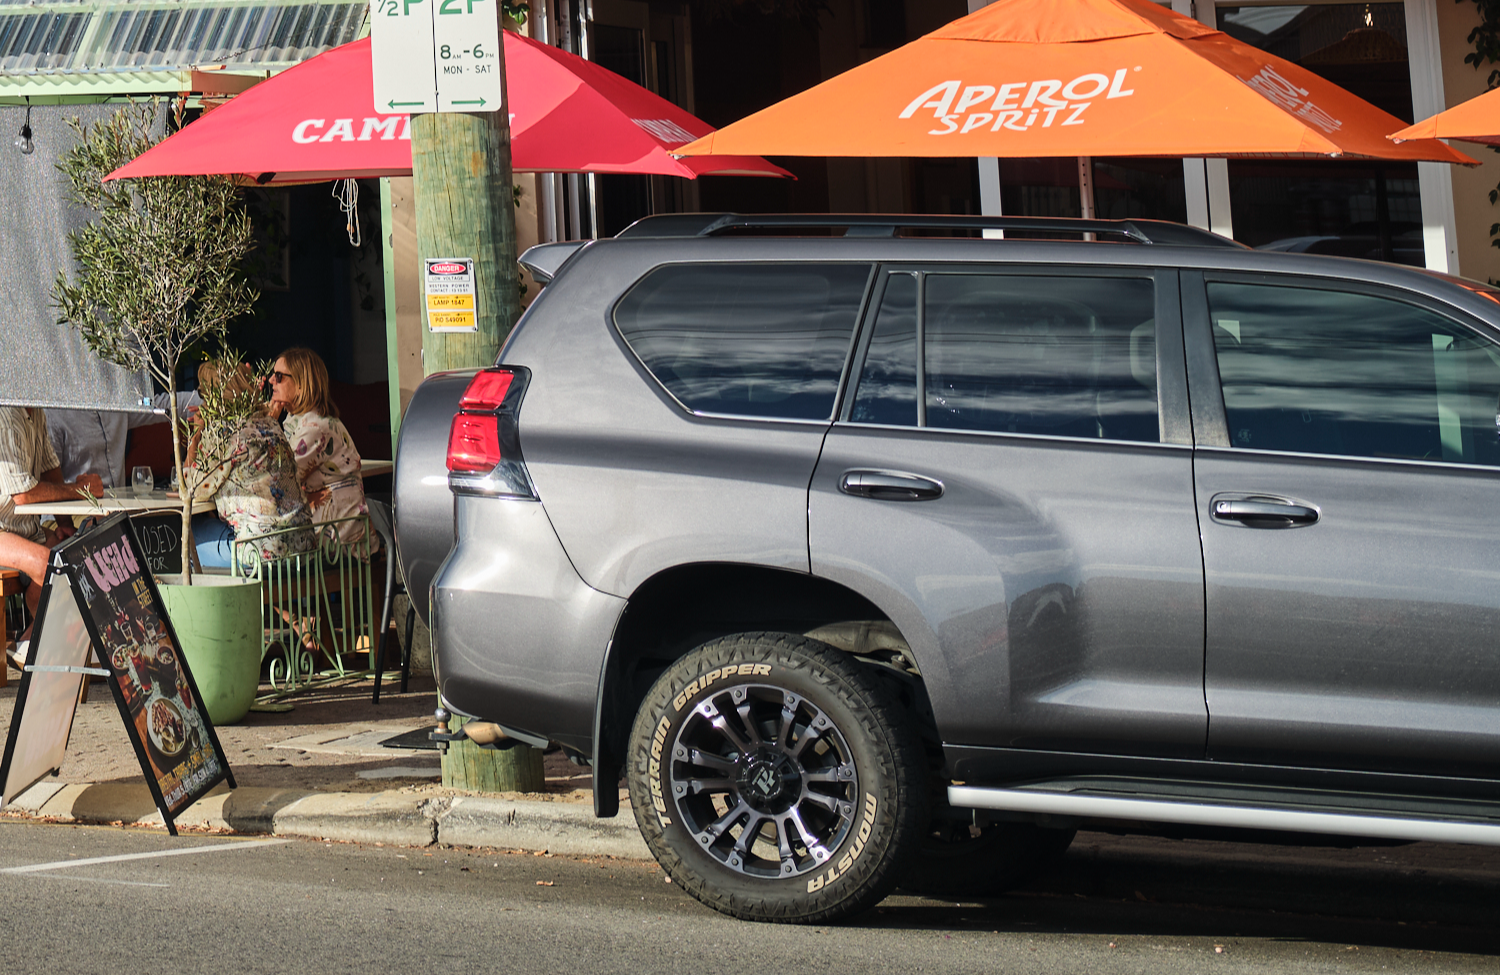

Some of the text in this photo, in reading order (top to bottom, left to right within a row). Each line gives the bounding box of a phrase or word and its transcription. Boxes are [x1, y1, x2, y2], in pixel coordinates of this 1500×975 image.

[443, 65, 463, 74] MON
[475, 64, 492, 73] SAT
[143, 524, 178, 555] OSED
[673, 663, 773, 712] GRIPPER
[649, 715, 673, 829] TERRAIN
[807, 792, 878, 893] MONSTA
